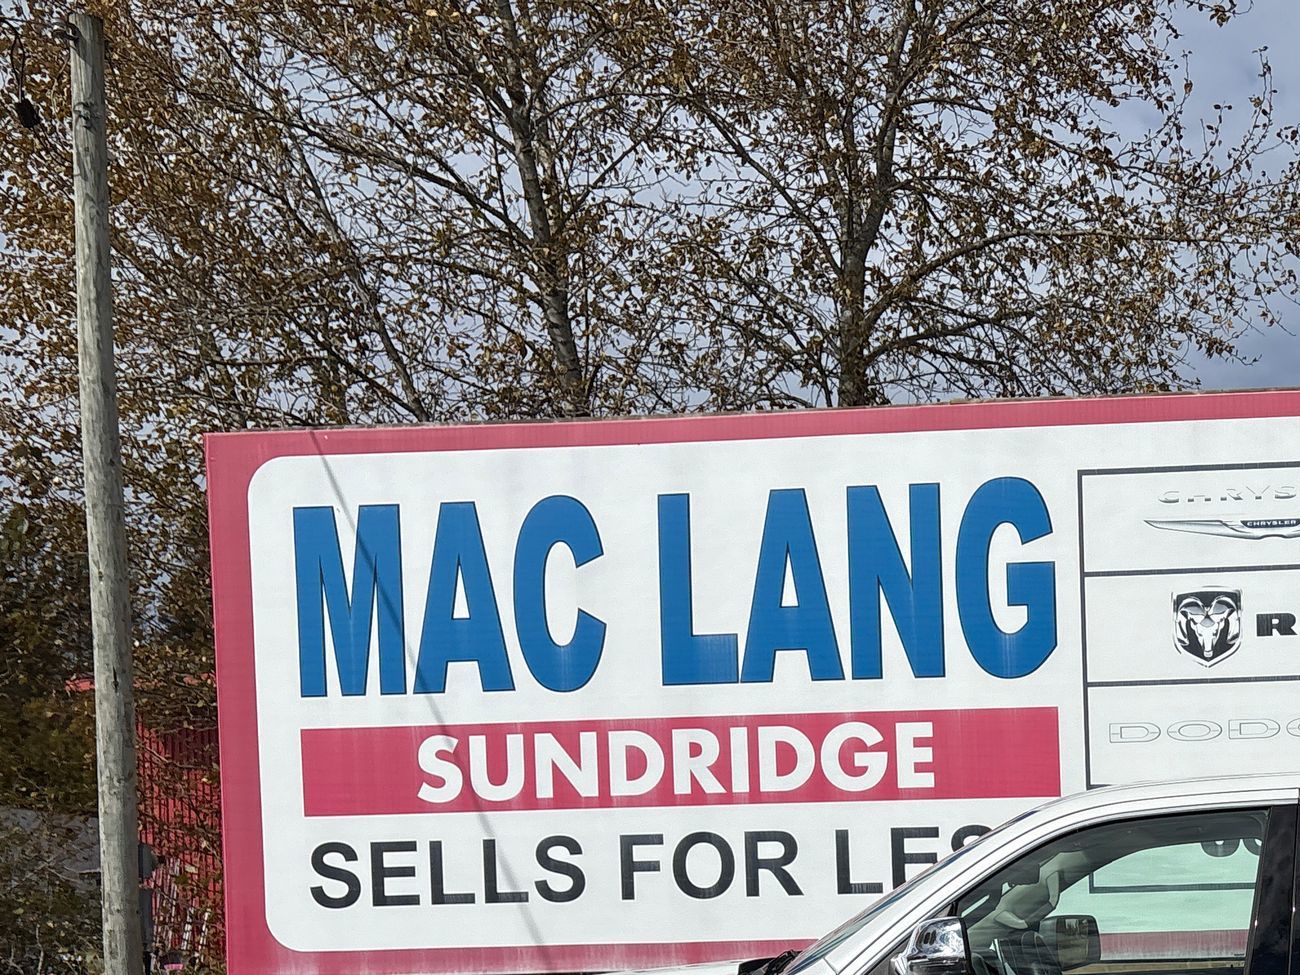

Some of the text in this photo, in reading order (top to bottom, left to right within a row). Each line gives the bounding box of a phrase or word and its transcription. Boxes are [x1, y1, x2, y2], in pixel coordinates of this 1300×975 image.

[1246, 519, 1297, 528] CHRYSLER
[293, 476, 1058, 698] MAC LANG
[416, 720, 936, 804] SUNDRIDGE
[309, 834, 586, 909] SELLS
[619, 829, 805, 901] FOR
